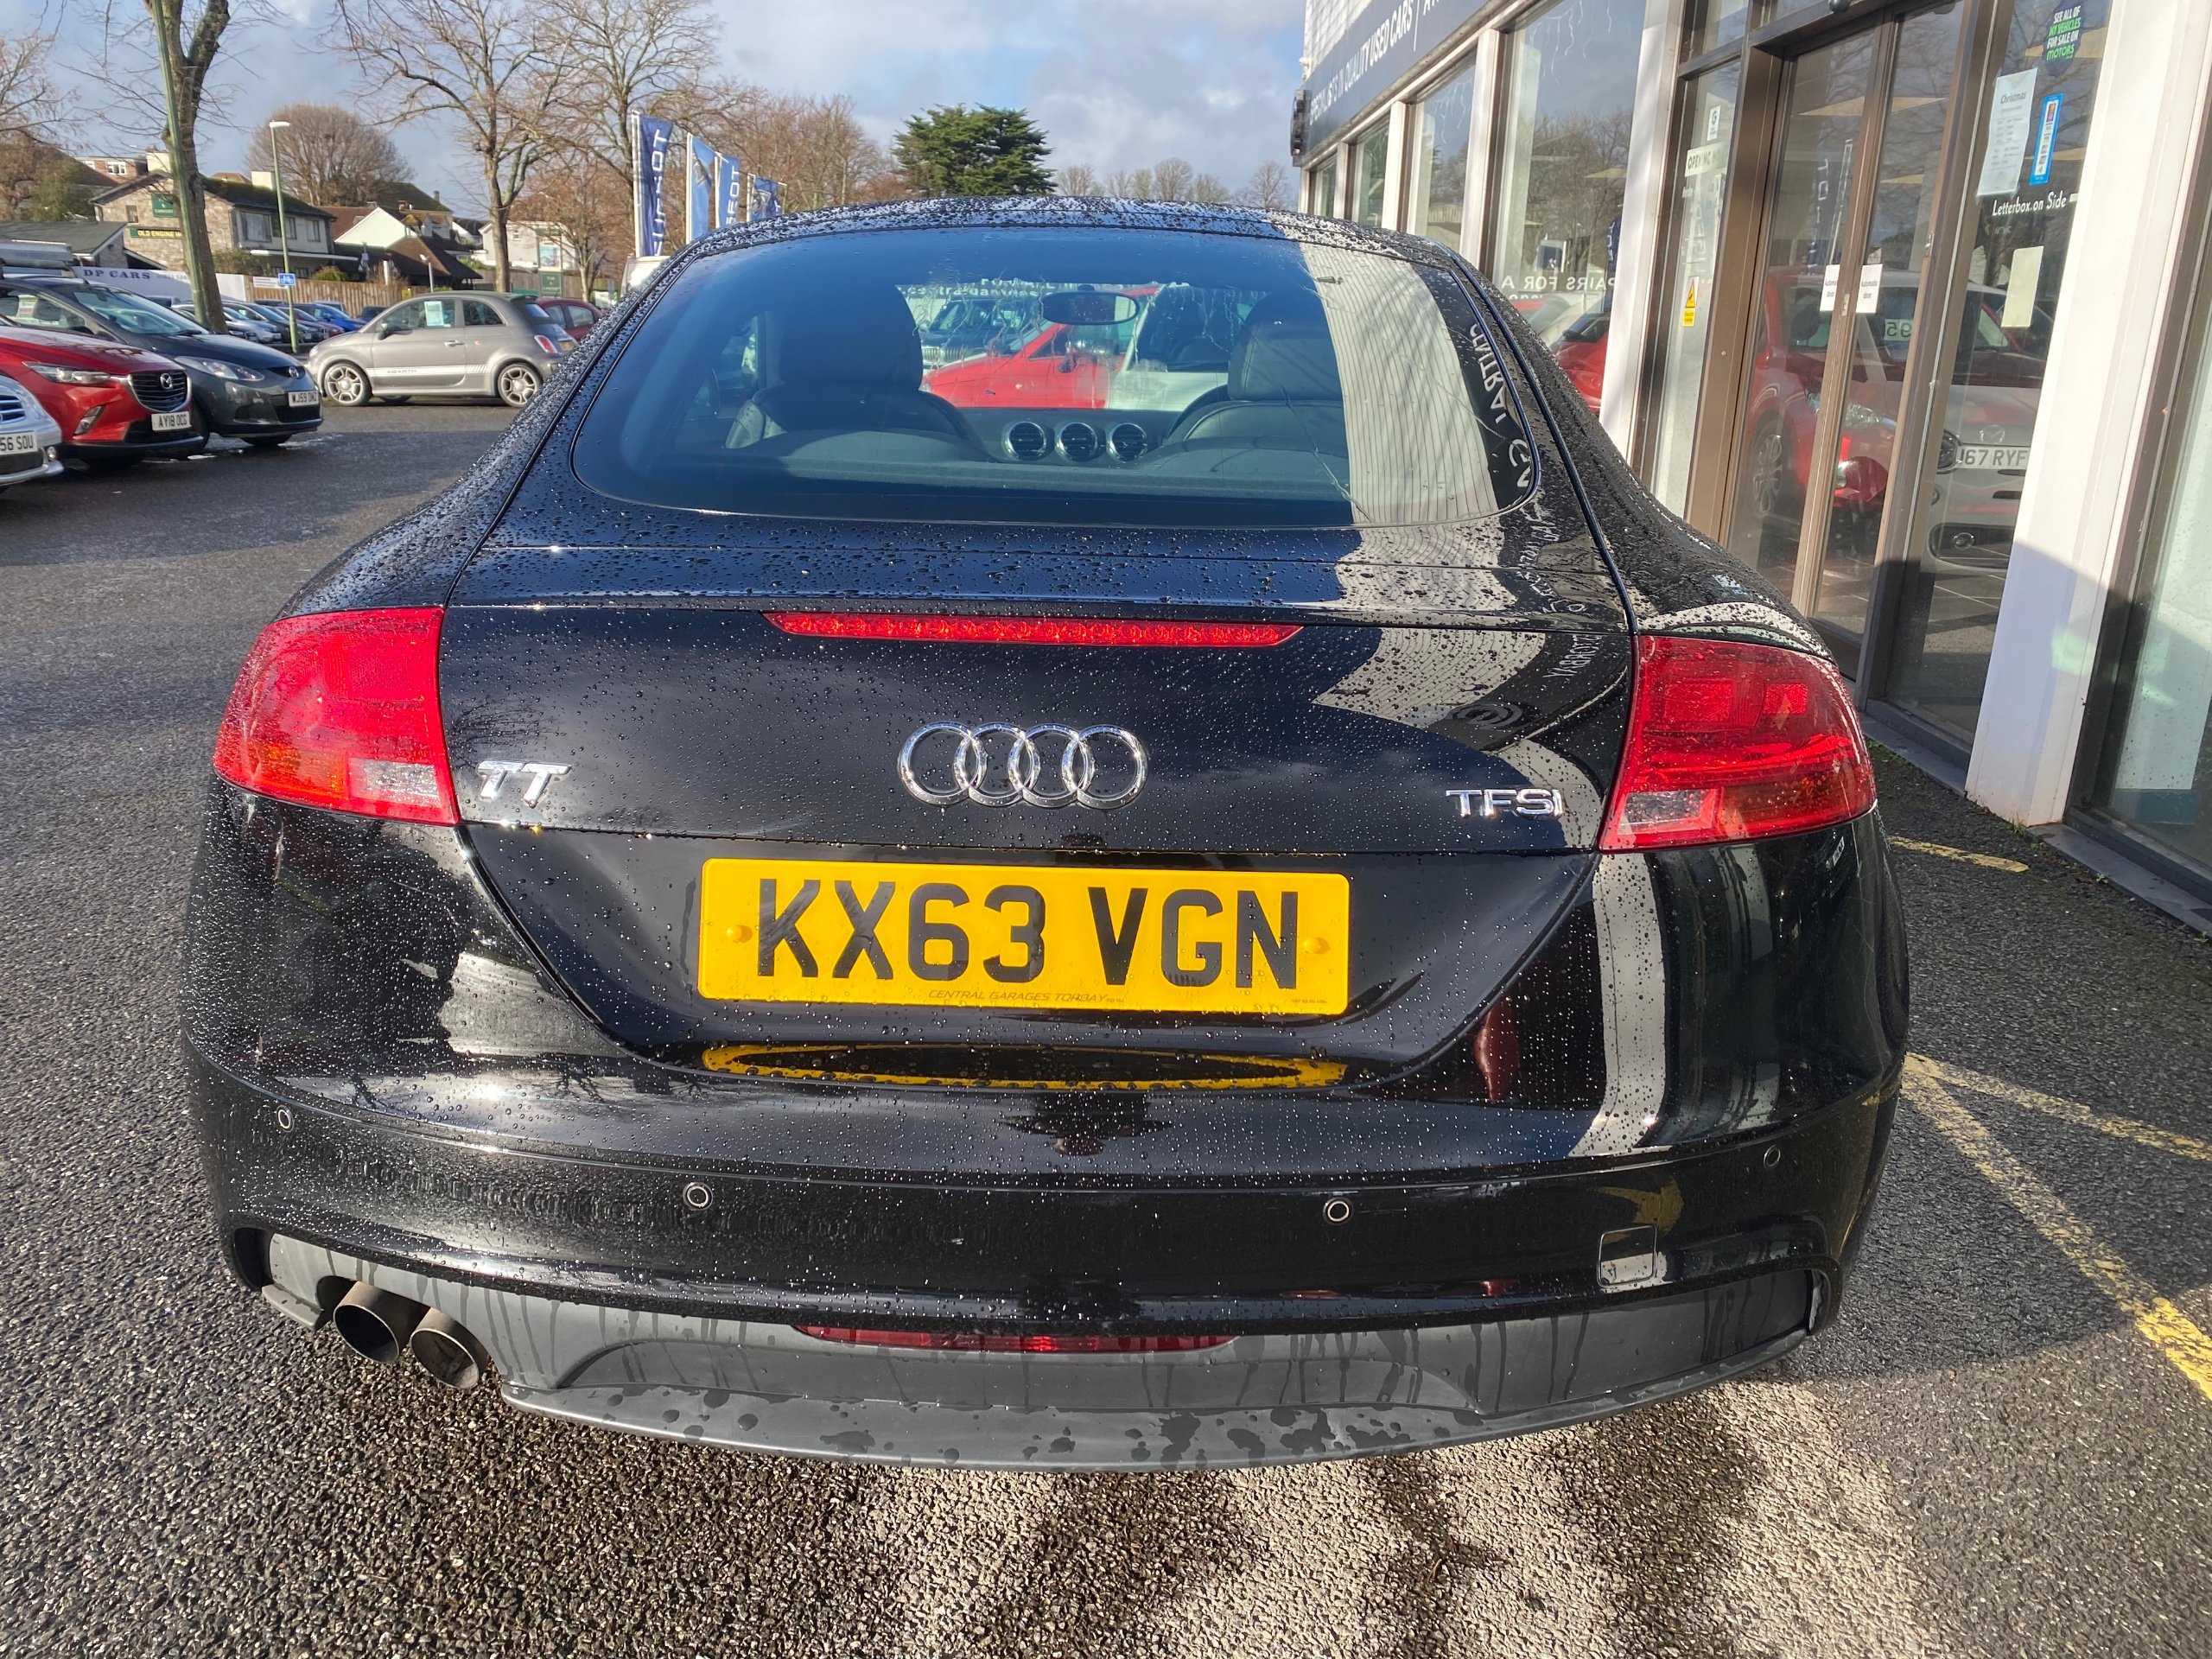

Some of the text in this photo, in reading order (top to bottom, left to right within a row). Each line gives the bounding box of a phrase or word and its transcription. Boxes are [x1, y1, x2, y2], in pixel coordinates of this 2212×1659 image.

[2054, 5, 2082, 23] SEE ALL OF
[2057, 16, 2082, 35] VEHICLES
[1344, 38, 1371, 92] QUALITY
[1370, 18, 1390, 67] USED
[1390, 0, 1413, 48] CARS
[2047, 29, 2080, 49] FOR SALE ON
[2046, 43, 2075, 61] MOTORS
[2000, 91, 2026, 105] Christmas
[1688, 150, 1712, 170] OPENING
[1992, 190, 2067, 217] Letterbox on Side
[110, 270, 150, 279] CARS
[17, 434, 34, 449] SOU
[1993, 449, 2028, 467] RYF
[476, 760, 571, 809] TT
[1446, 787, 1564, 819] TFSI
[757, 878, 1299, 990] KX63 VGN
[928, 989, 985, 1001] CENTRAL
[988, 991, 1050, 1002] GARAGES
[1054, 993, 1108, 1003] TORBAY
